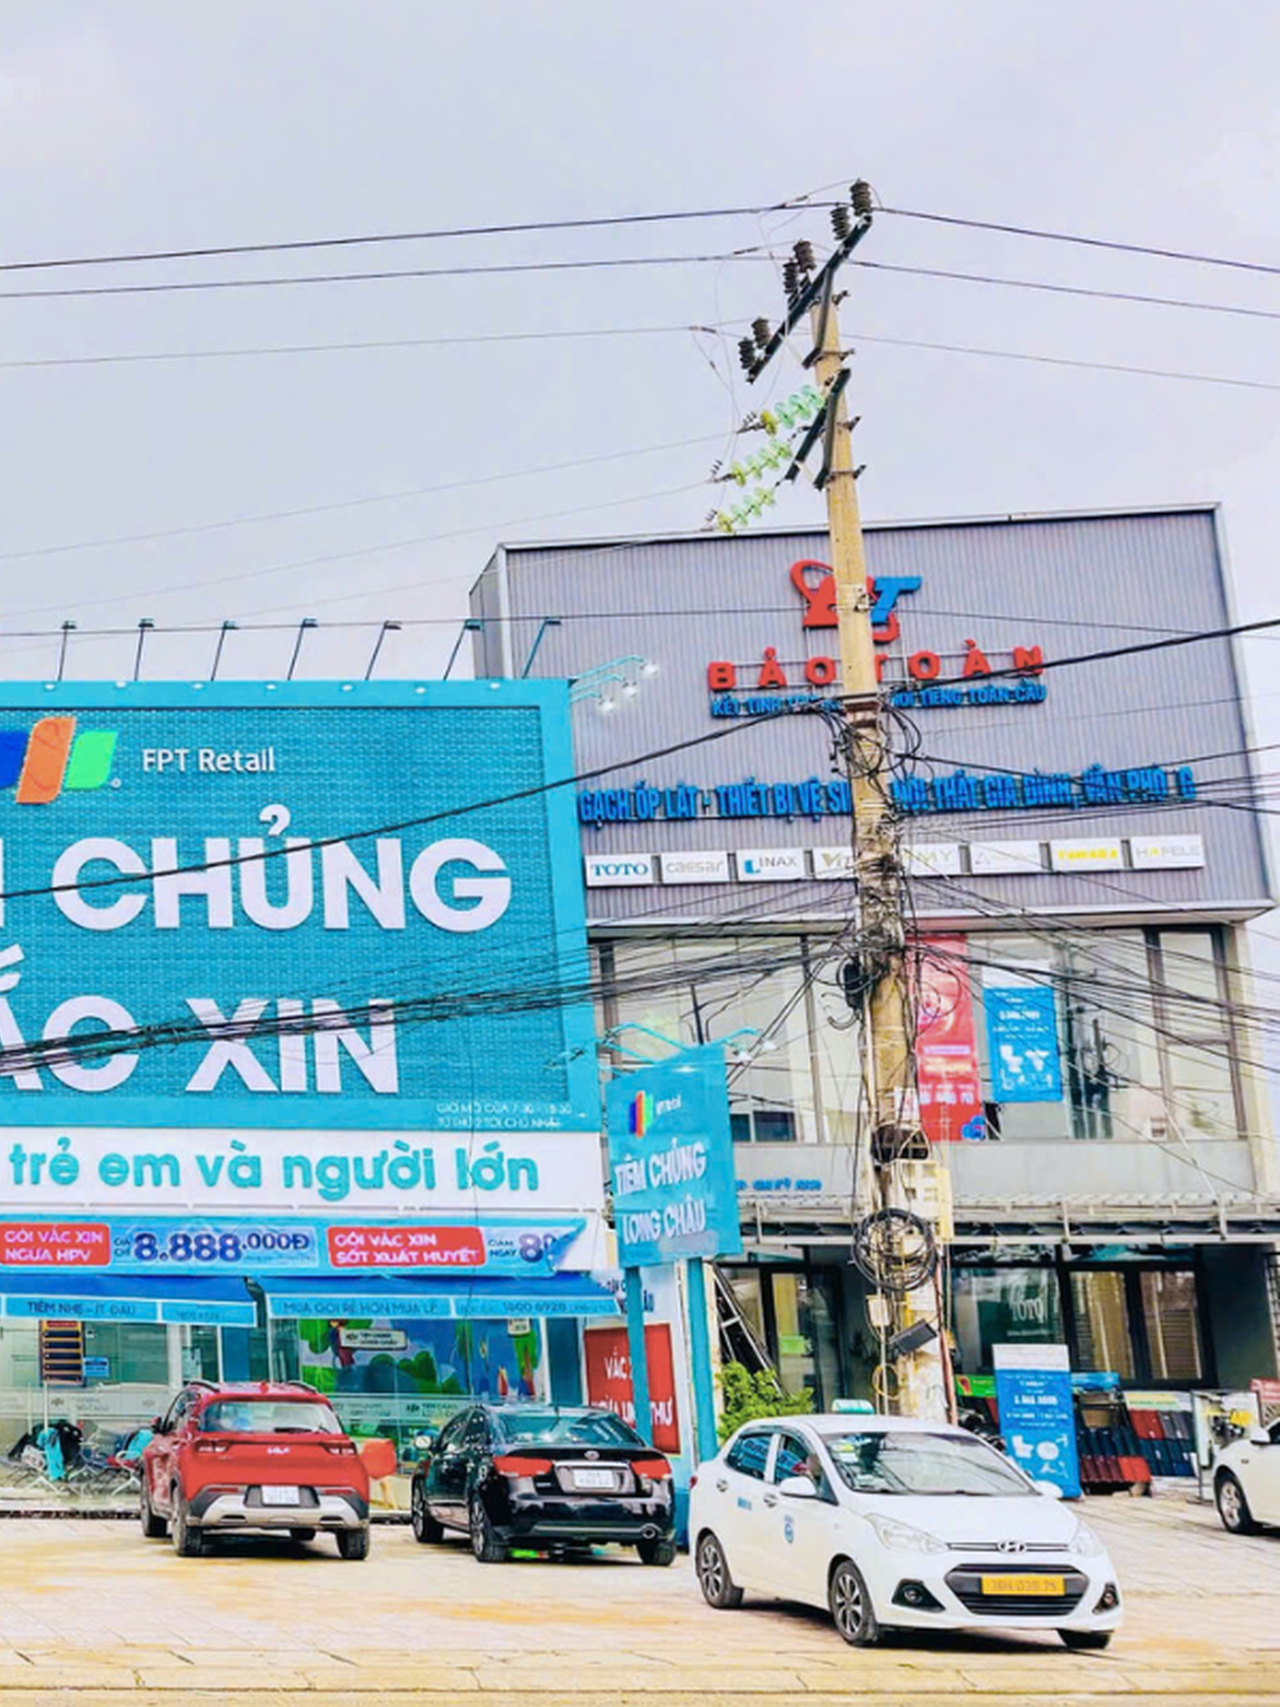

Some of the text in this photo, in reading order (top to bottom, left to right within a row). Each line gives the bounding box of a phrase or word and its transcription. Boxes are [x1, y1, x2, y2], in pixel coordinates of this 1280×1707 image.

[708, 647, 836, 690] BẢO
[142, 745, 276, 773] FPT Retail
[580, 787, 630, 828] GẠCH
[635, 778, 659, 820] ỐP
[773, 782, 795, 822] BỊ
[982, 775, 1018, 807] GIA
[52, 803, 511, 932] CHỦNG
[592, 855, 799, 877] TOTO caesar INAX
[184, 997, 399, 1093] XIN
[8, 1137, 80, 1186] trẻ
[98, 1151, 181, 1188] em
[196, 1139, 262, 1188] và
[283, 1139, 437, 1200] người
[456, 1141, 539, 1192] lớn
[615, 1137, 707, 1195] TIÊM CHỦNG
[4, 1228, 33, 1244] GÓI
[75, 1230, 103, 1243] XIN
[622, 1194, 706, 1245] LONG CHÂU
[57, 1249, 91, 1261] HPV
[408, 1235, 437, 1246] XIN
[26, 1299, 55, 1313] TIÊM
[283, 1302, 310, 1314] MUA
[392, 1302, 421, 1314] MUA
